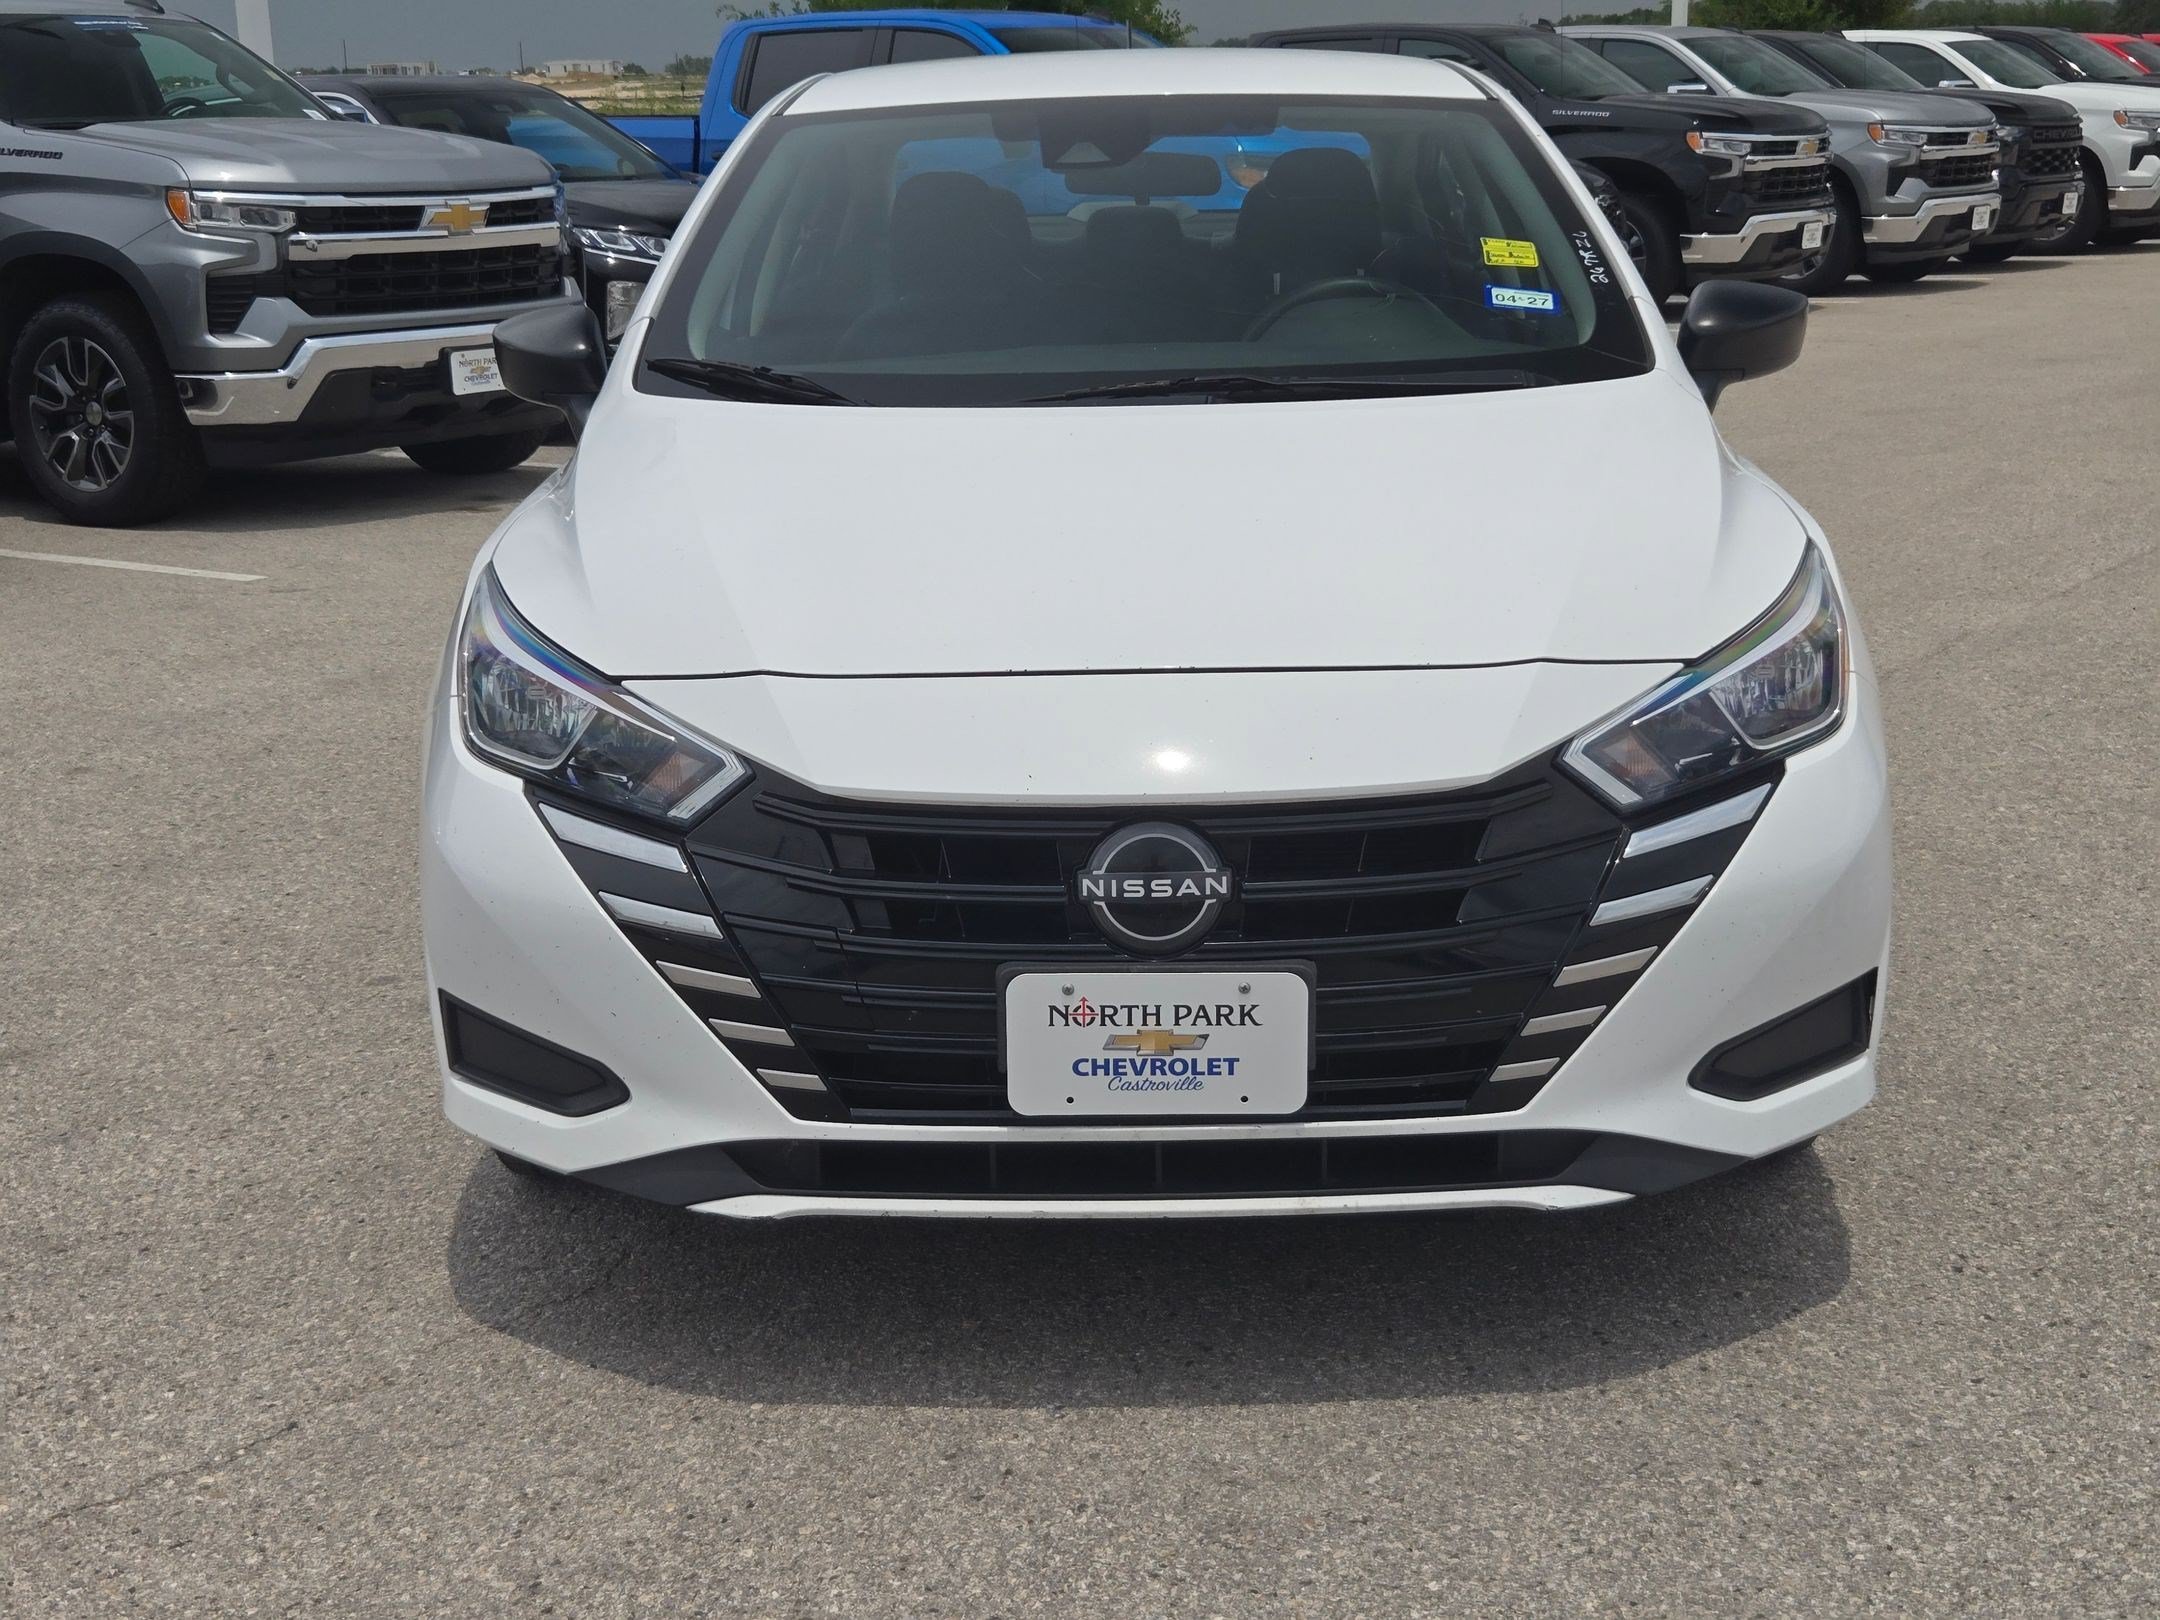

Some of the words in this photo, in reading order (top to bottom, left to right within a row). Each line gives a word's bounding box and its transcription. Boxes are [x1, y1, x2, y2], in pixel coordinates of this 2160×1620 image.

[1552, 109, 1610, 117] SILVERADO
[1081, 876, 1228, 898] NISSAN
[1048, 1001, 1162, 1027] NORTH
[1173, 1003, 1263, 1026] PARK
[1071, 1057, 1240, 1076] CHEVROLET
[1107, 1075, 1204, 1092] Castroville
